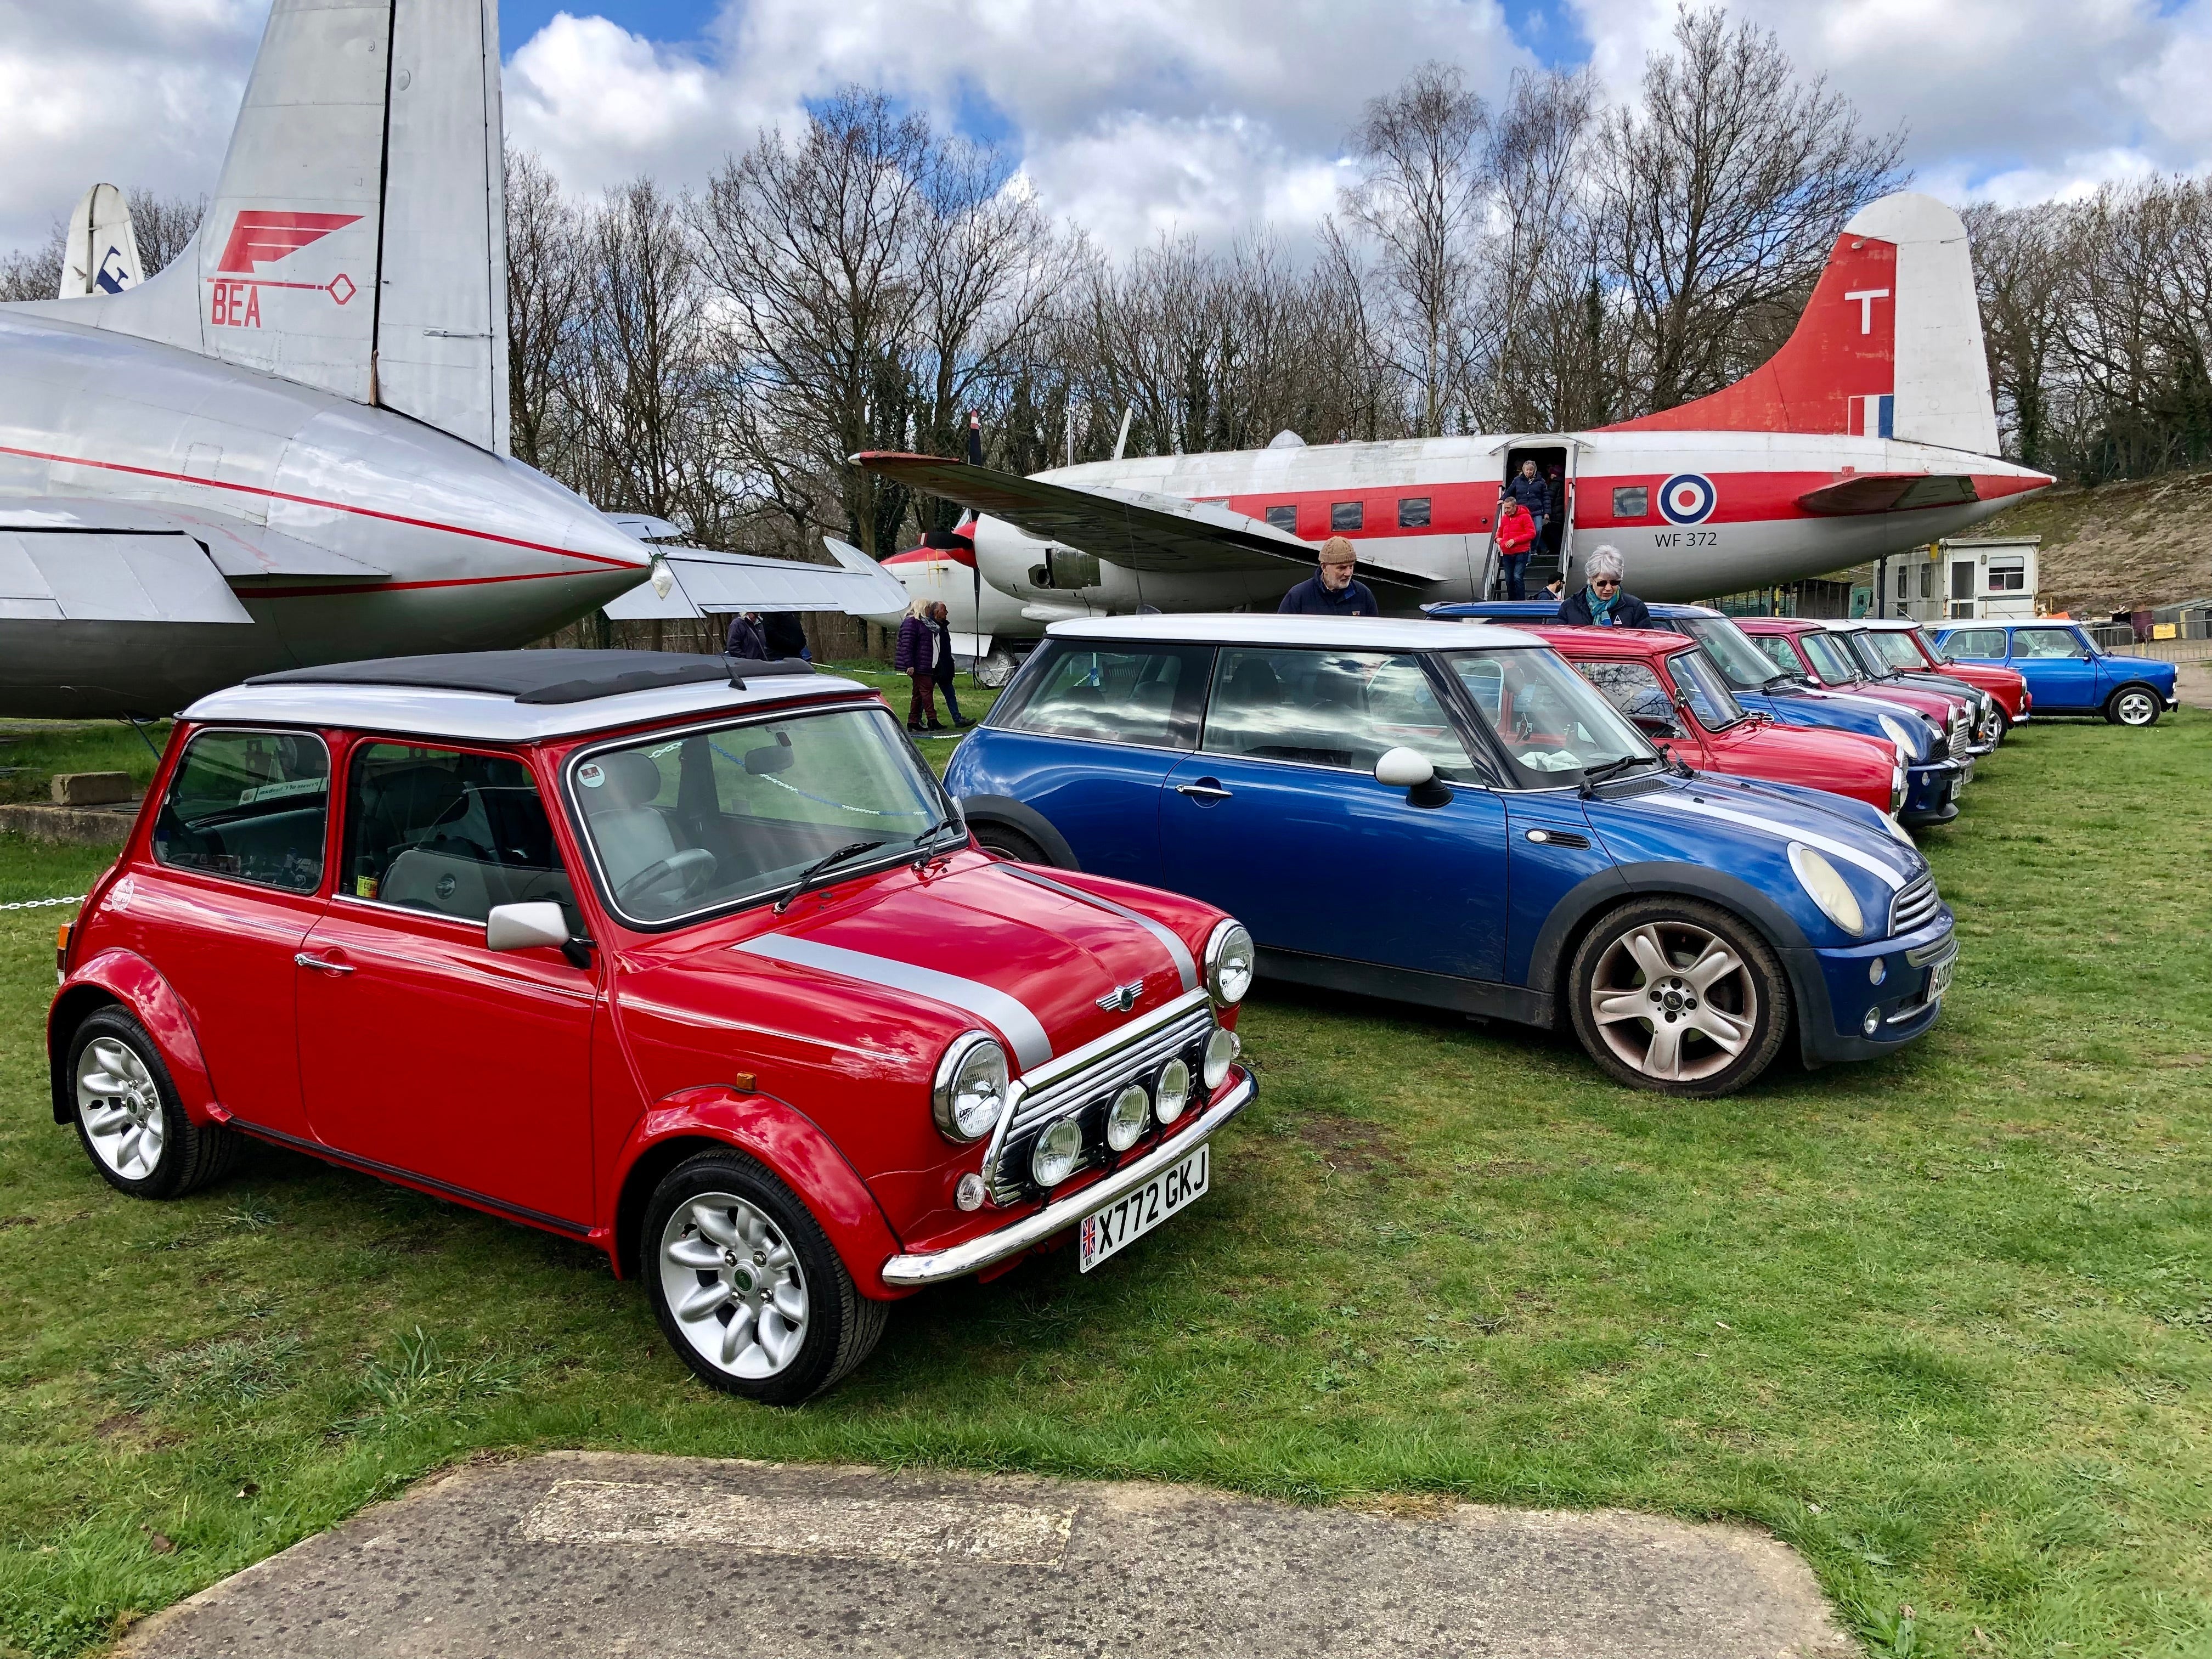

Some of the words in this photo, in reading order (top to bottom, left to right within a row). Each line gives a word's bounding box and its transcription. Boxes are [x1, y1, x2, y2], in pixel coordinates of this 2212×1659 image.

[212, 283, 261, 328] BEA
[1844, 289, 1889, 335] T
[1655, 533, 1681, 548] WF
[1686, 532, 1717, 546] 372
[1099, 1182, 1159, 1255] X772
[1166, 1150, 1205, 1209] GKJ
[1085, 1255, 1092, 1267] UK
